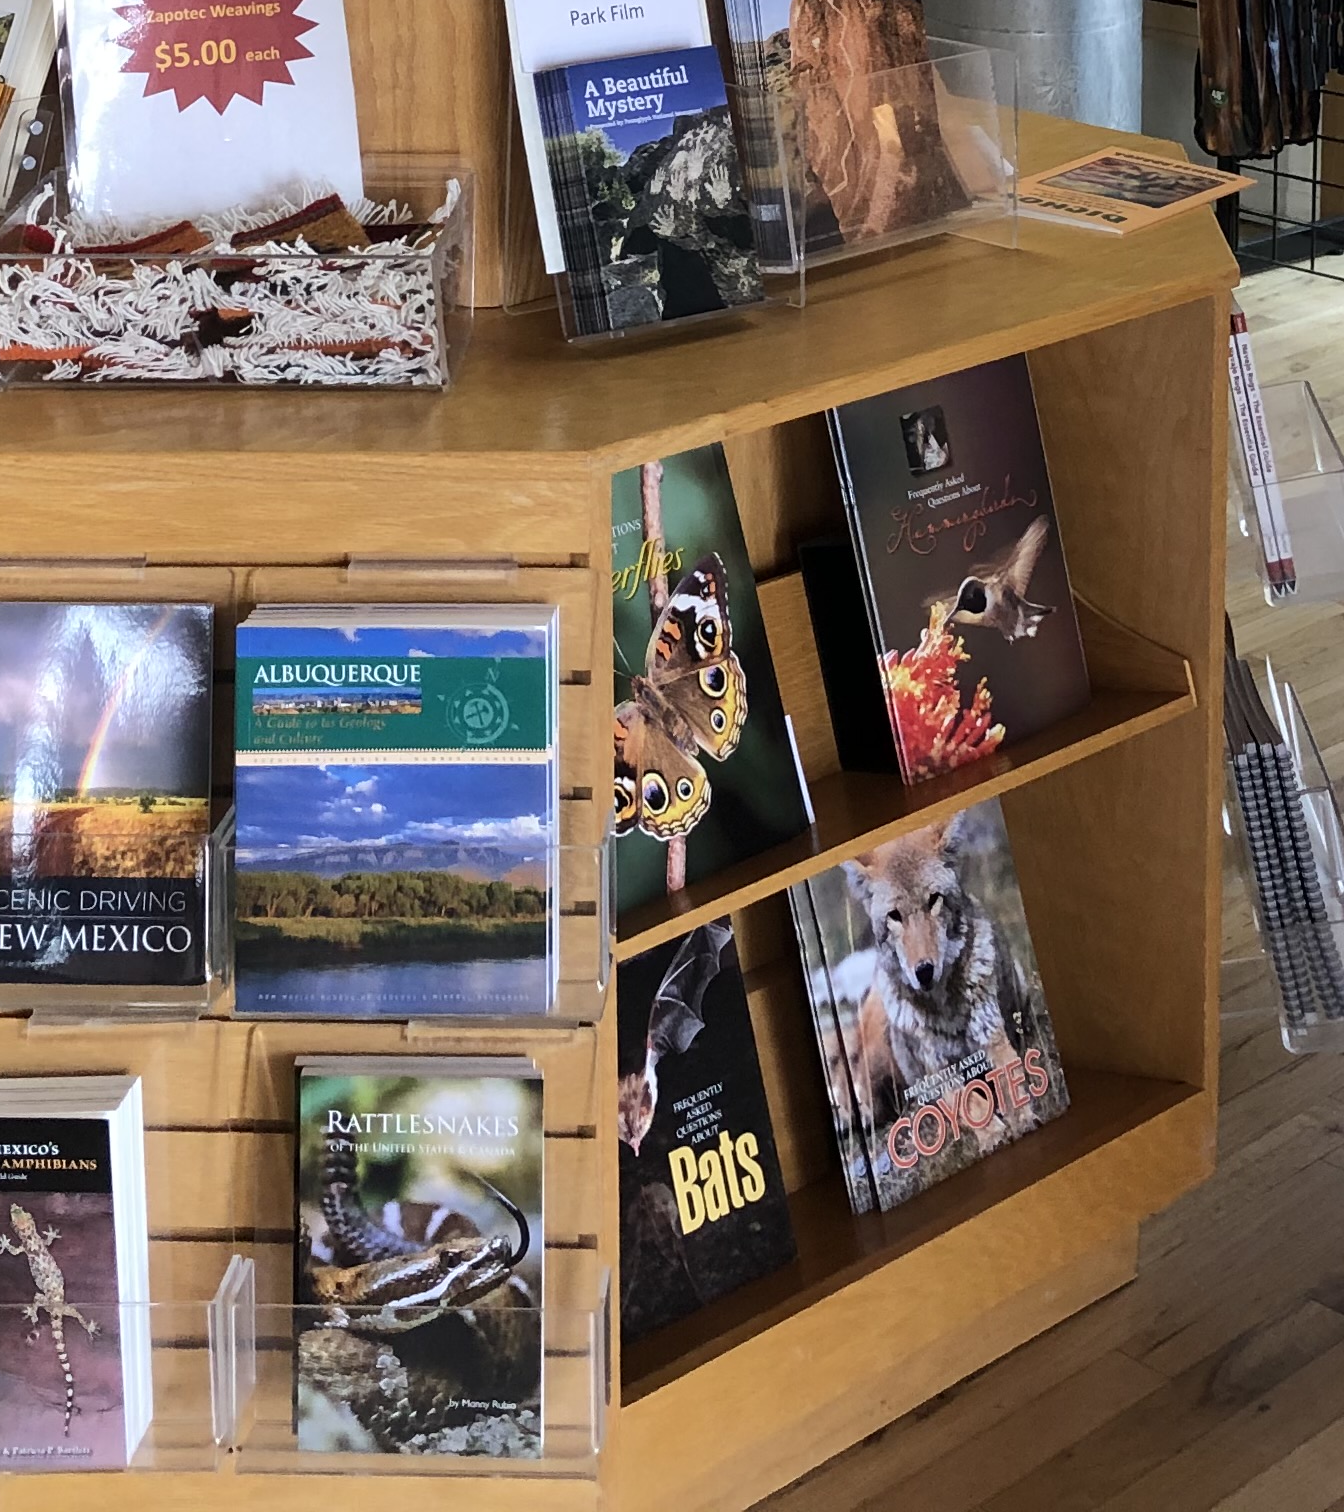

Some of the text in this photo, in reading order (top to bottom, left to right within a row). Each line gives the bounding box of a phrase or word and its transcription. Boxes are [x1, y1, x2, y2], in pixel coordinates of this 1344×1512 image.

[146, 0, 282, 27] Zapotec Weavings
[570, 3, 645, 27] Park Film
[154, 38, 282, 73] $5.00 each
[584, 65, 690, 98] A Beautiful
[587, 92, 666, 121] Mystery
[1242, 343, 1274, 474] Navajo Rugs The Essential Guide
[907, 472, 965, 502] Frequently Asked
[926, 482, 982, 510] Questions About
[254, 663, 422, 686] ALBUQUERQUE
[78, 889, 187, 913] DRIVING
[60, 925, 193, 954] MEXICO
[959, 1049, 987, 1071] ASKED
[966, 1057, 995, 1083] ABOUT
[672, 1082, 724, 1114] FREQUENTLY
[685, 1102, 714, 1121] ASKED
[886, 1048, 1050, 1170] COYOTES
[326, 1109, 521, 1138] RATTLESNAKES
[675, 1109, 724, 1140] QUESTIONS
[690, 1124, 720, 1146] ABOUT
[330, 1141, 416, 1155] OF THE UNITED
[1, 1158, 98, 1171] AMPHIBIANS
[667, 1129, 767, 1236] Bats
[448, 1398, 518, 1410] by Manny Rubio
